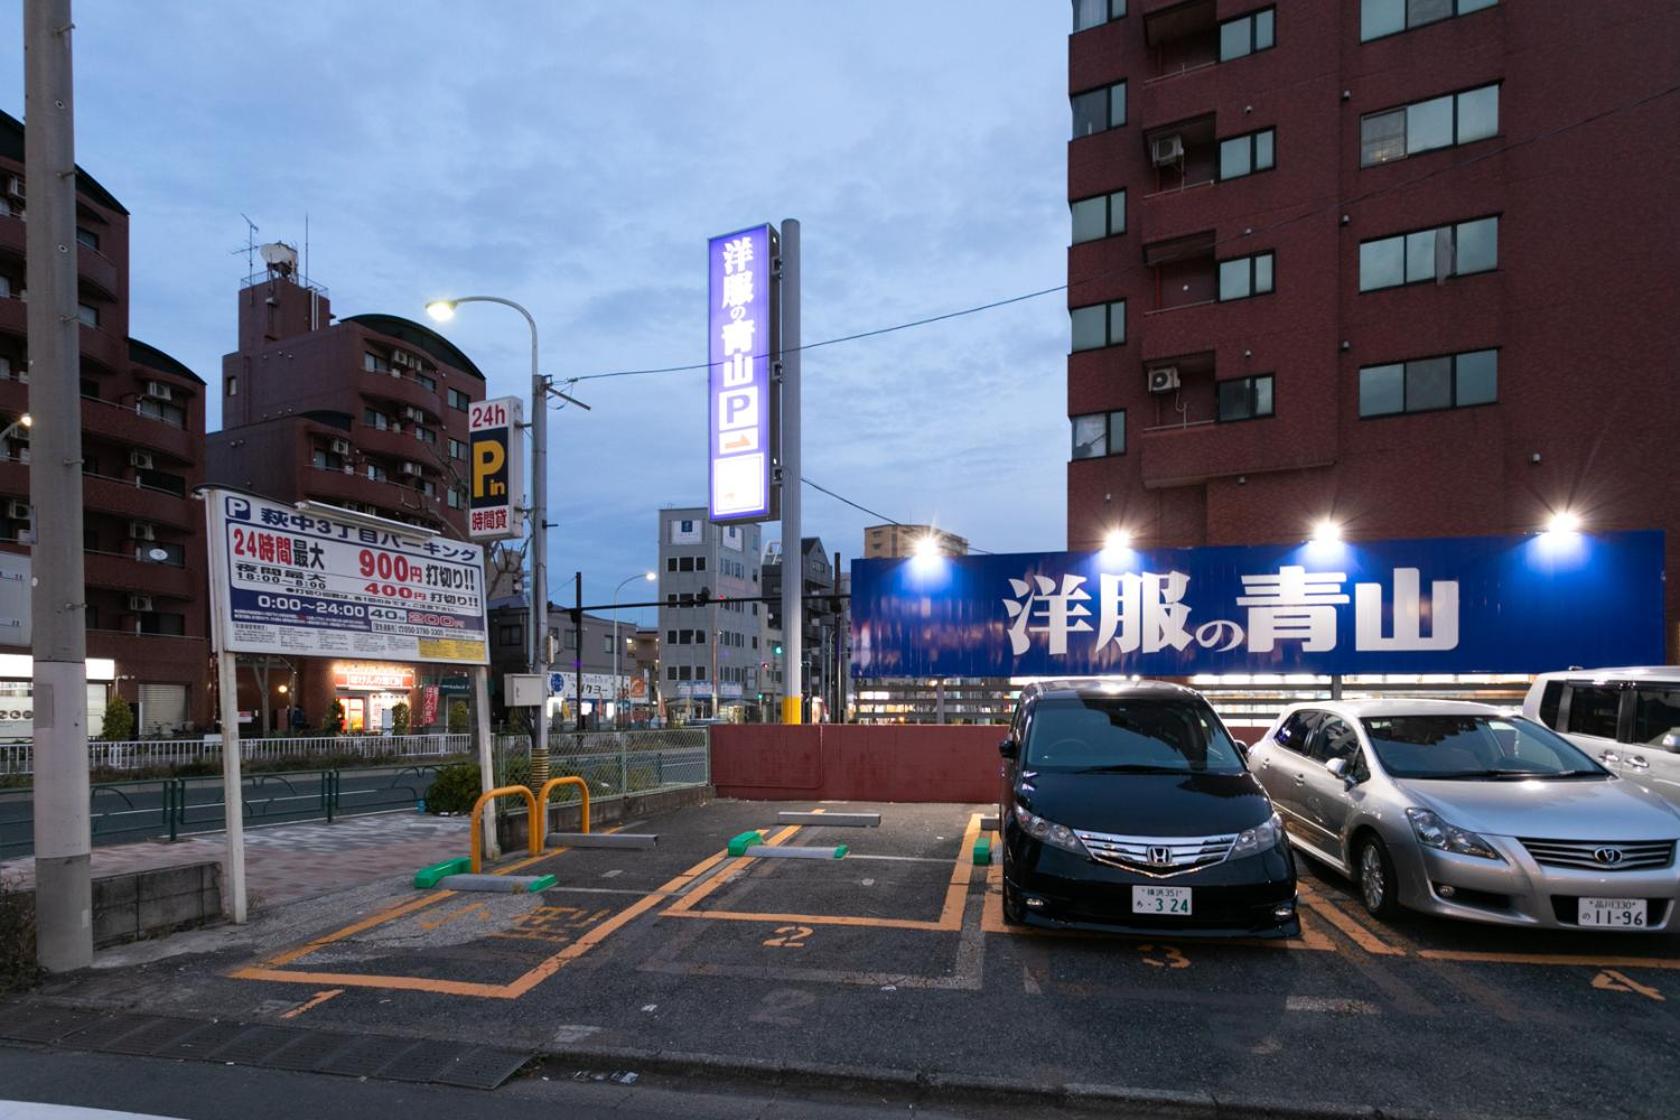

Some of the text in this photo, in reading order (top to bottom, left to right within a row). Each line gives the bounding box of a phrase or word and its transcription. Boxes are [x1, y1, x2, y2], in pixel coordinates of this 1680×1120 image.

[722, 236, 756, 388] 洋服の青山
[472, 404, 505, 428] 24h
[727, 394, 750, 424] P
[472, 509, 507, 531] 時間貸
[234, 528, 325, 570] 24時間最大
[1002, 566, 1459, 655] 洋服の青山
[763, 926, 813, 947] 2
